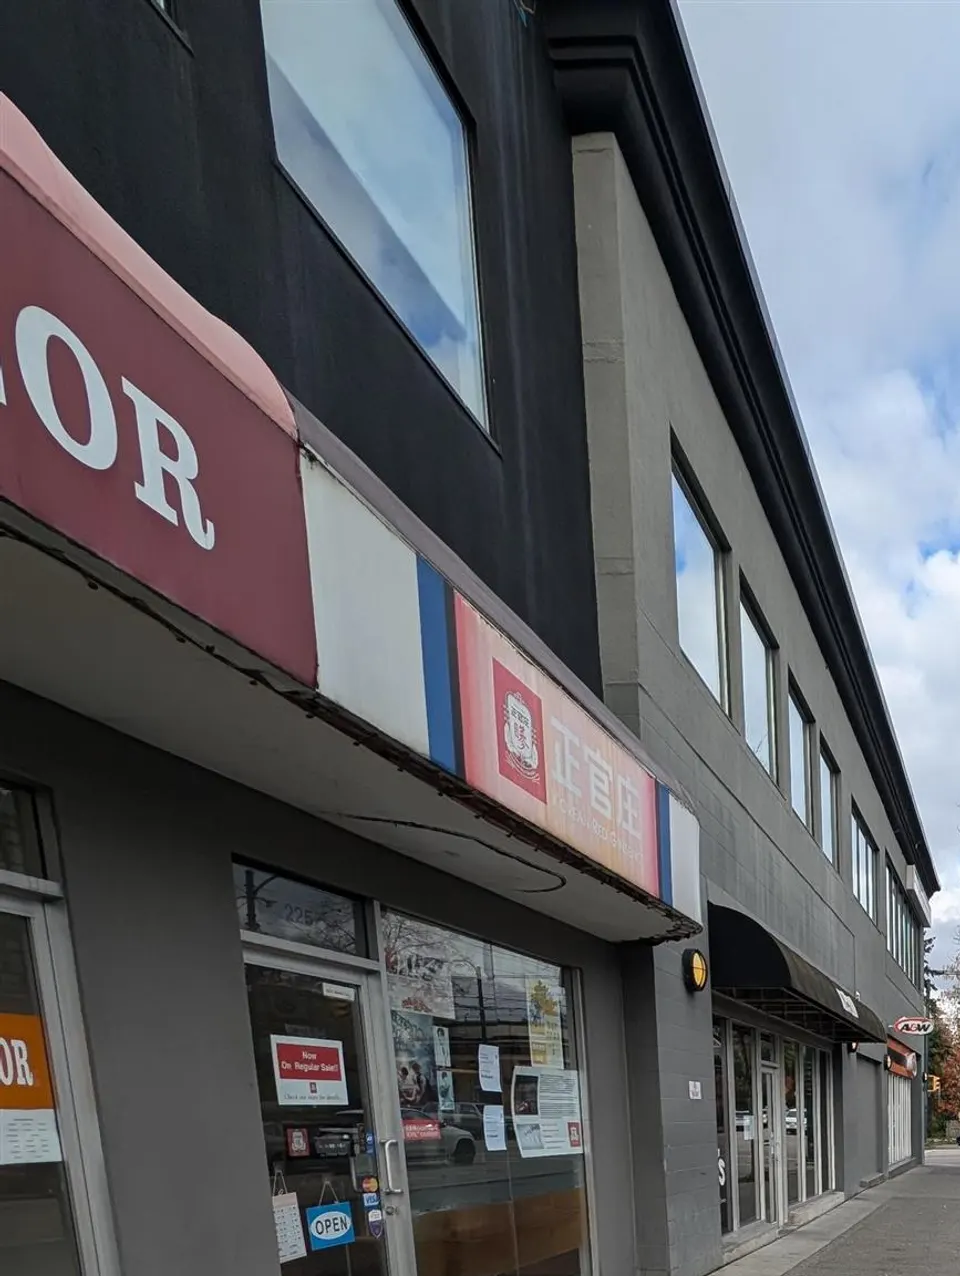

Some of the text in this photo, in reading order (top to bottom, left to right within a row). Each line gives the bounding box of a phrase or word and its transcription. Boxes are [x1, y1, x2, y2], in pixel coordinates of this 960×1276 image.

[0, 305, 215, 550] OR
[899, 1023, 930, 1032] A&W
[302, 1050, 317, 1060] Now
[281, 1061, 292, 1070] On
[294, 1062, 320, 1073] Regular
[315, 1217, 348, 1235] OPEN
